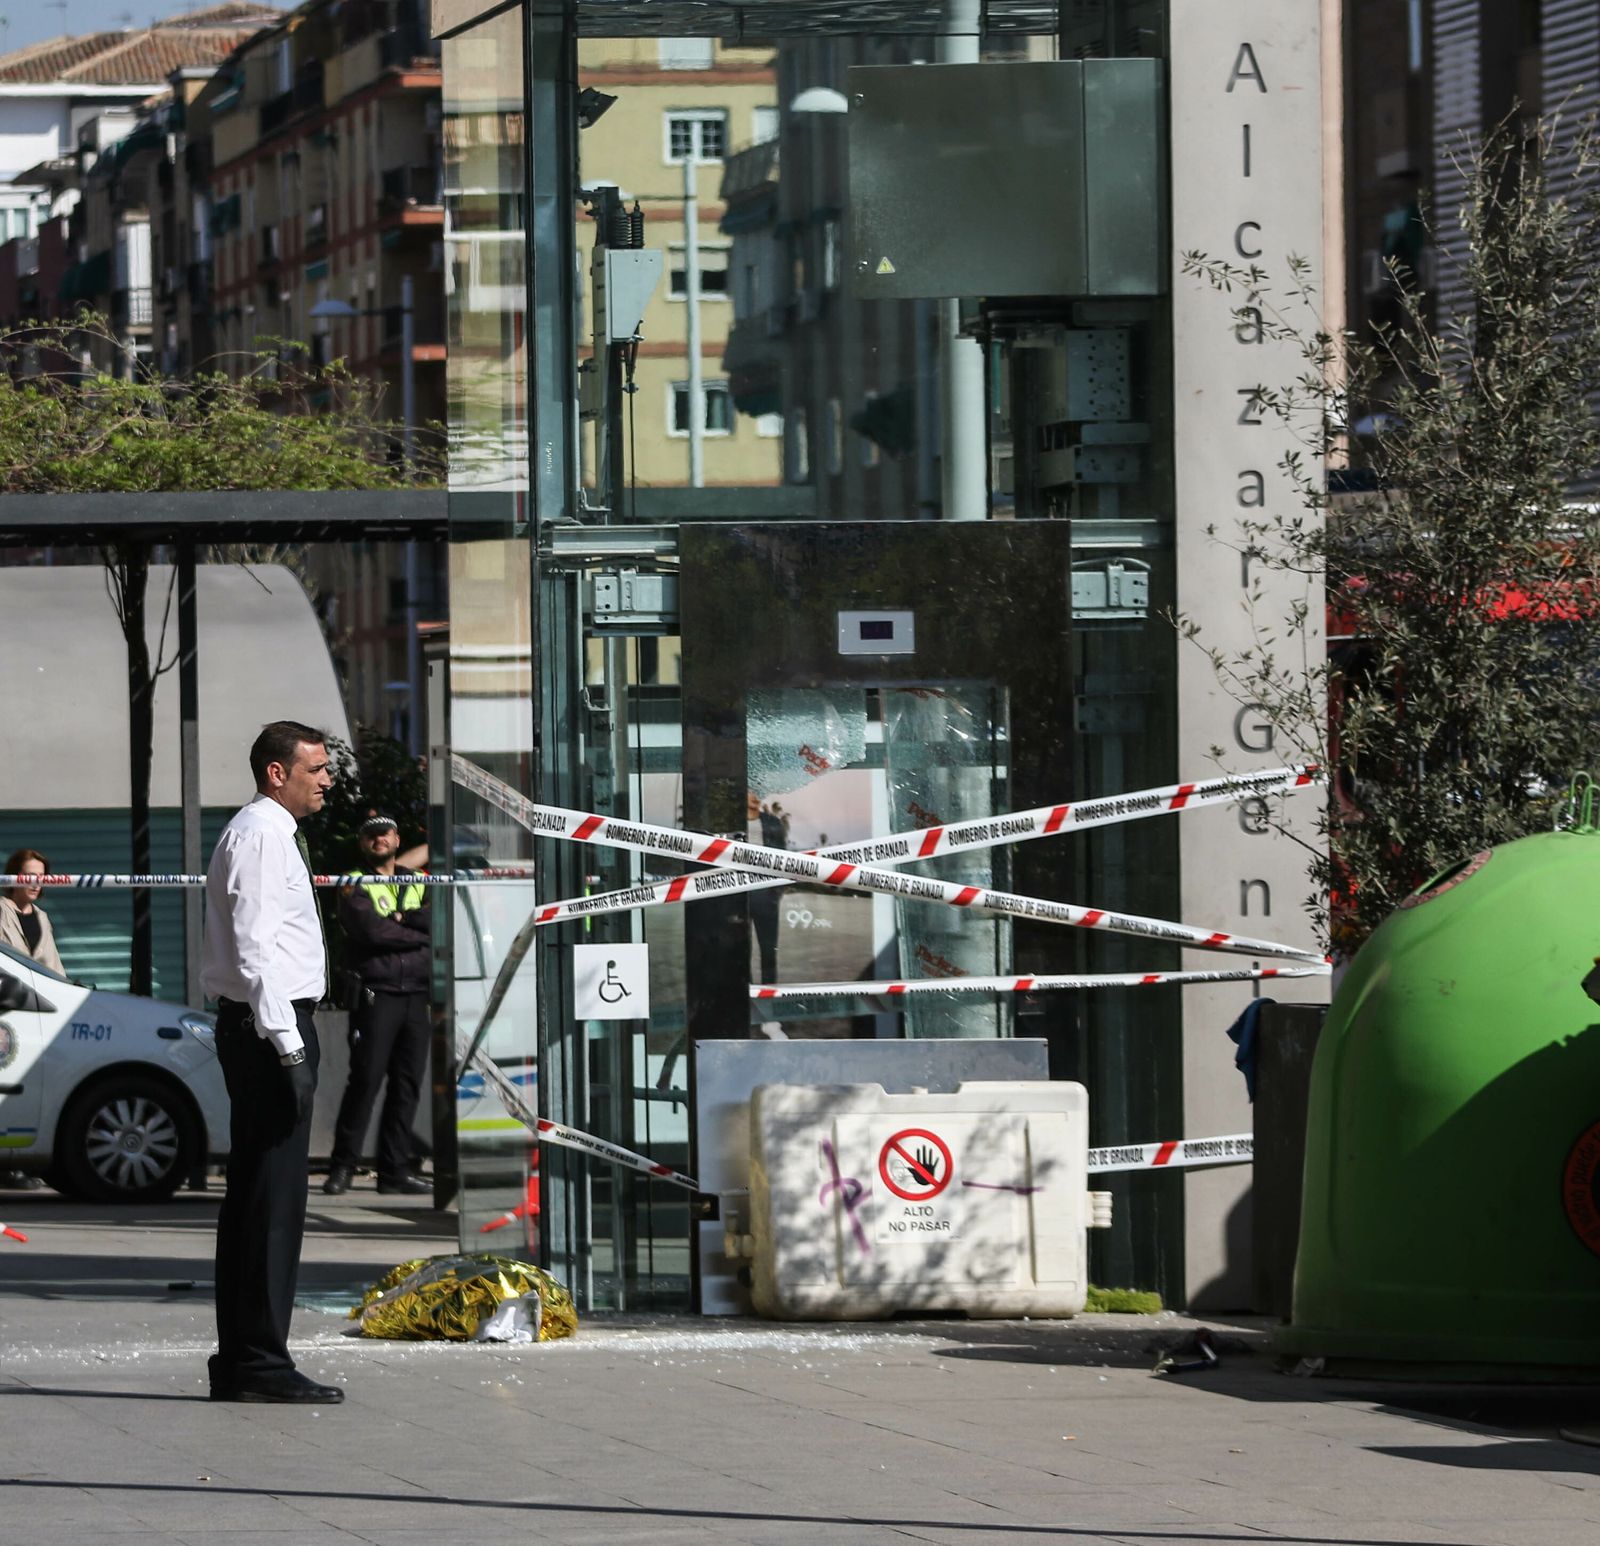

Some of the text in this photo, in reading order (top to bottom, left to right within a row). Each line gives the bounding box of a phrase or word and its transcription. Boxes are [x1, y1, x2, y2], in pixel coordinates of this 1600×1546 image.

[1074, 795, 1161, 823] BOMBEROS DE GRANADA
[533, 811, 567, 833] GRANADA
[949, 817, 1036, 847] BOMBEROS DE GRANADA
[606, 824, 694, 855] BOMBEROS DE GRANADA
[863, 847, 874, 862] DE
[875, 840, 910, 861] GRANADA
[732, 847, 772, 870] BOMBEROS
[773, 855, 784, 872] DE
[784, 857, 819, 879] GRANADA
[694, 871, 737, 893] BOMBEROS
[737, 870, 747, 887] DE
[858, 870, 945, 900] BOMBEROS DE GRANADA
[620, 887, 656, 906] GRANADA
[984, 893, 1070, 921] BOMBEROS DE GRANADA
[71, 1022, 113, 1041] TR-01
[1100, 1150, 1110, 1166] DE
[1110, 1147, 1145, 1164] GRANADA
[1184, 1141, 1223, 1159] BOMBEROS
[1224, 1140, 1234, 1156] DE
[903, 1206, 934, 1217] ALTO
[888, 1220, 951, 1232] NO PASAR
